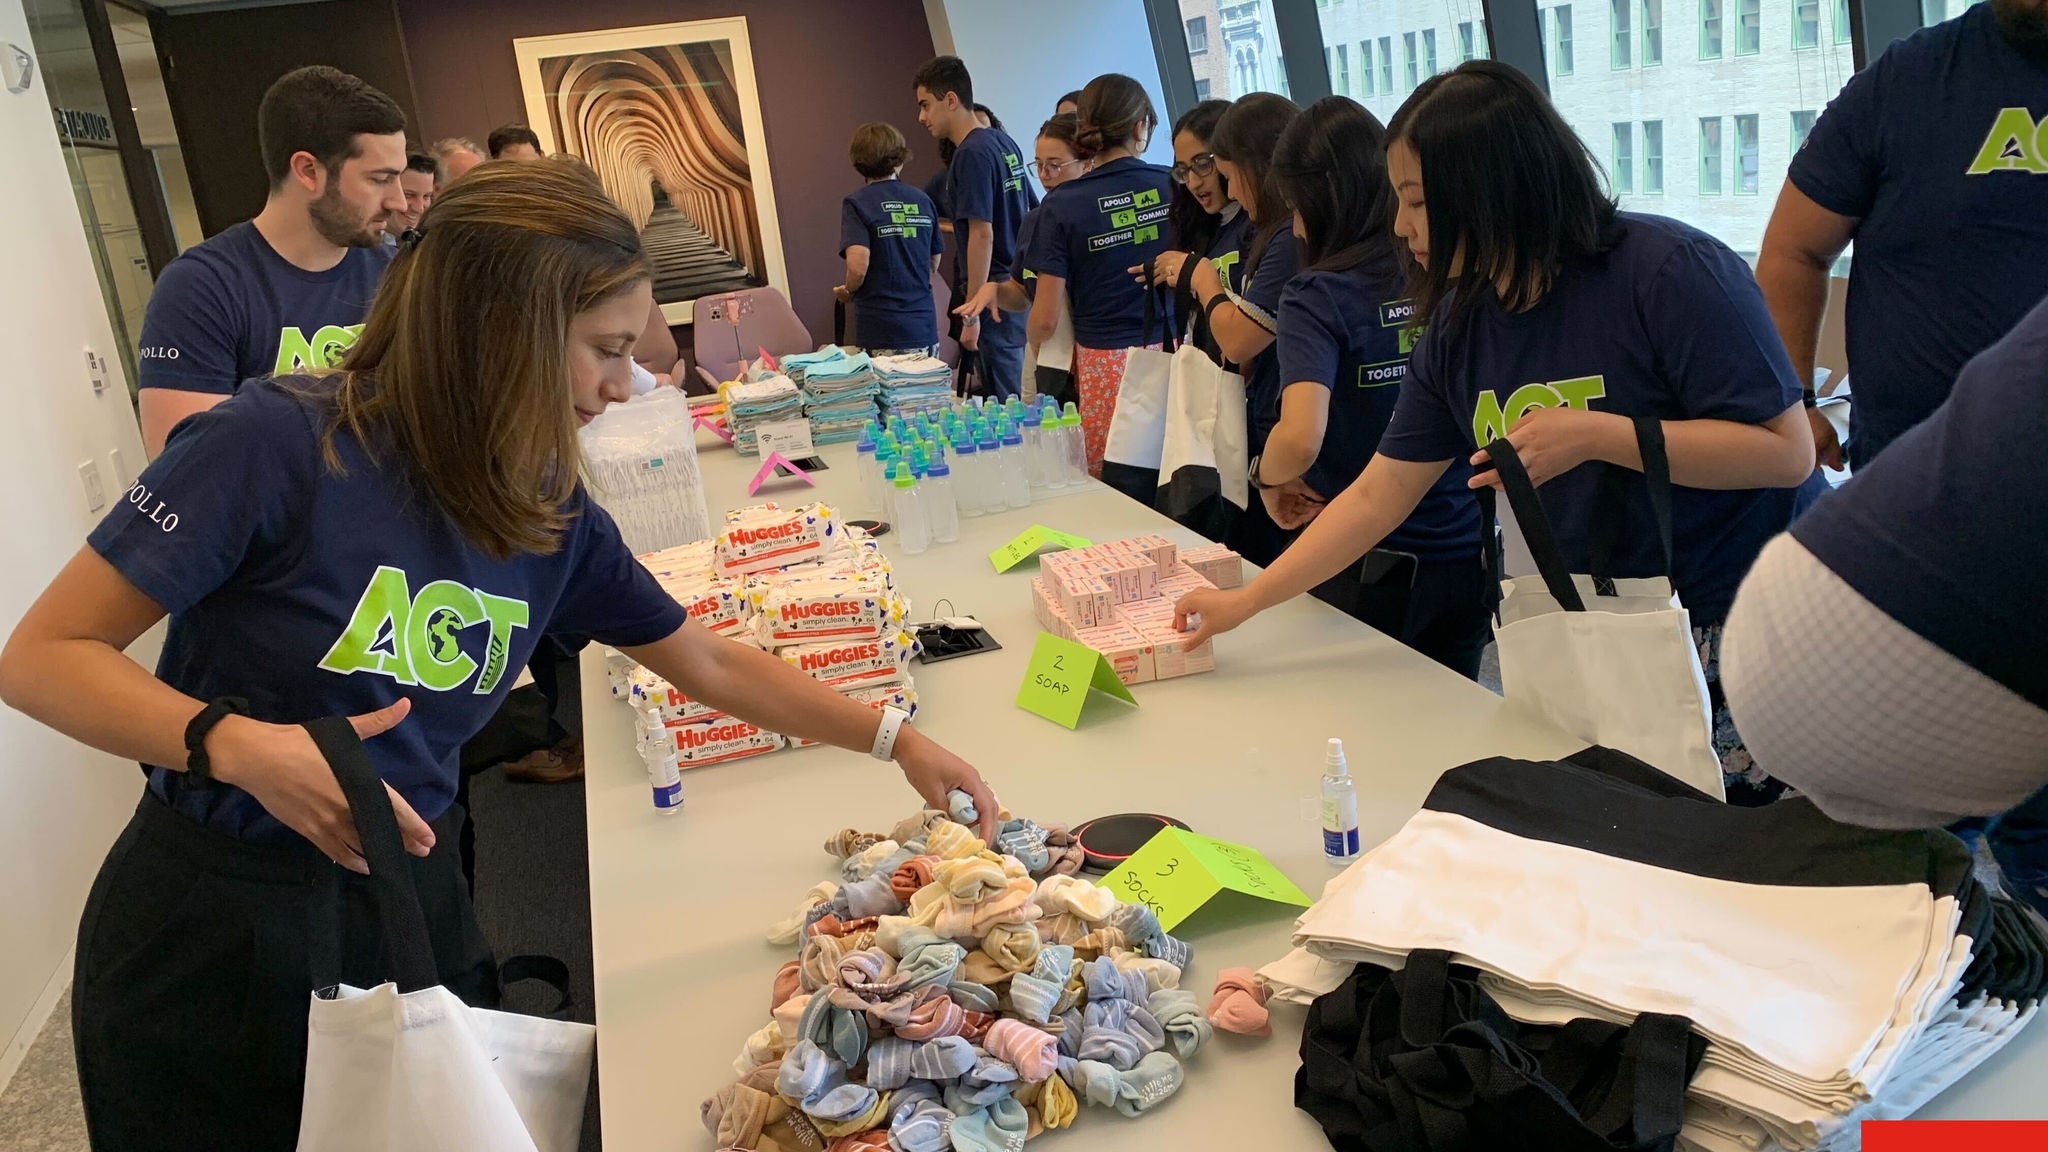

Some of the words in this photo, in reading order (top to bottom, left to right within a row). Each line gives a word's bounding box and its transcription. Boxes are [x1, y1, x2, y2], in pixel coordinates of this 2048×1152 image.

[1103, 196, 1131, 208] APOLLO
[1093, 231, 1133, 247] TOGETHER
[273, 323, 367, 377] AC
[729, 521, 803, 548] HUGGIES
[781, 601, 860, 621] HUGGIES
[317, 565, 529, 695] ACT
[800, 644, 879, 670] HUGGIES
[1053, 655, 1064, 671] 2
[1035, 674, 1070, 696] SOAP
[676, 724, 758, 749] HUGGIES
[1155, 858, 1179, 877] 3
